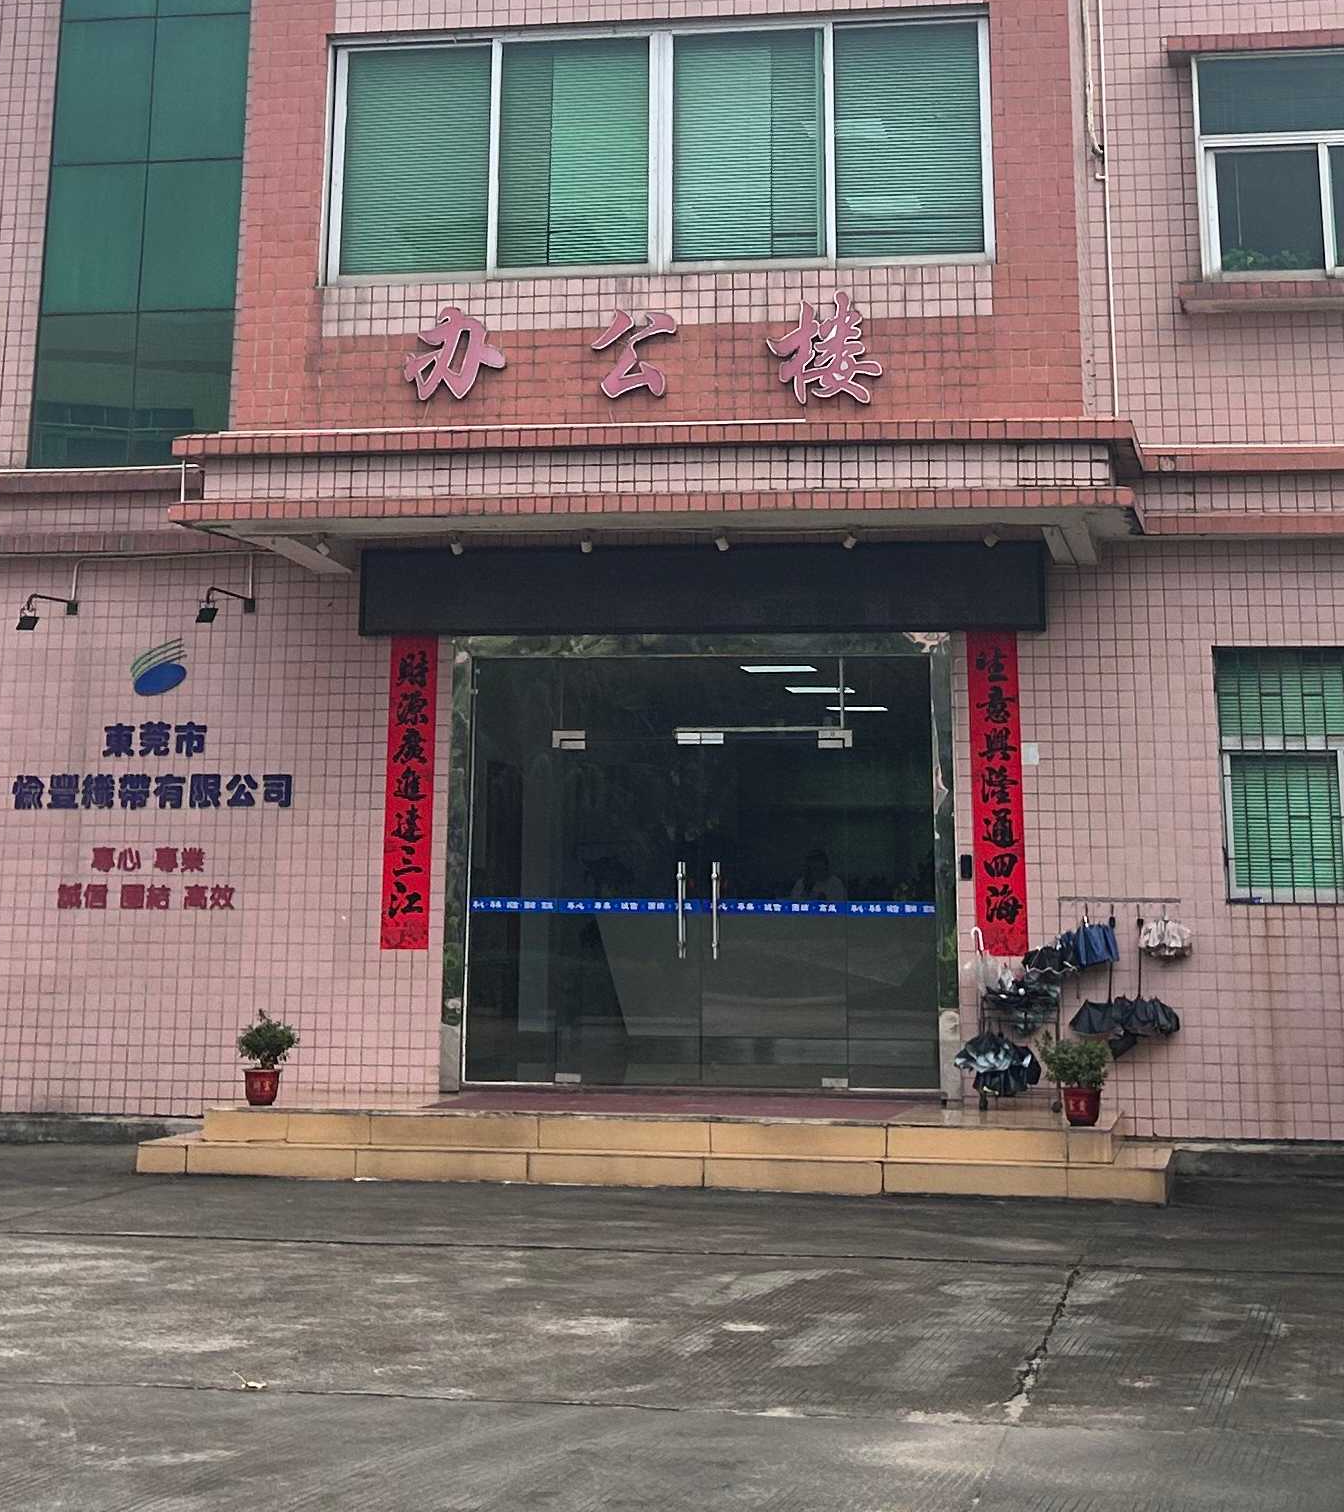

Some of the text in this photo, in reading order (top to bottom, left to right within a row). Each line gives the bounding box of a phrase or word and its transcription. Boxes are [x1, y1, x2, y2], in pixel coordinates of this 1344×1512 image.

[403, 290, 883, 405] 办公楼
[102, 721, 207, 757] 東莞市
